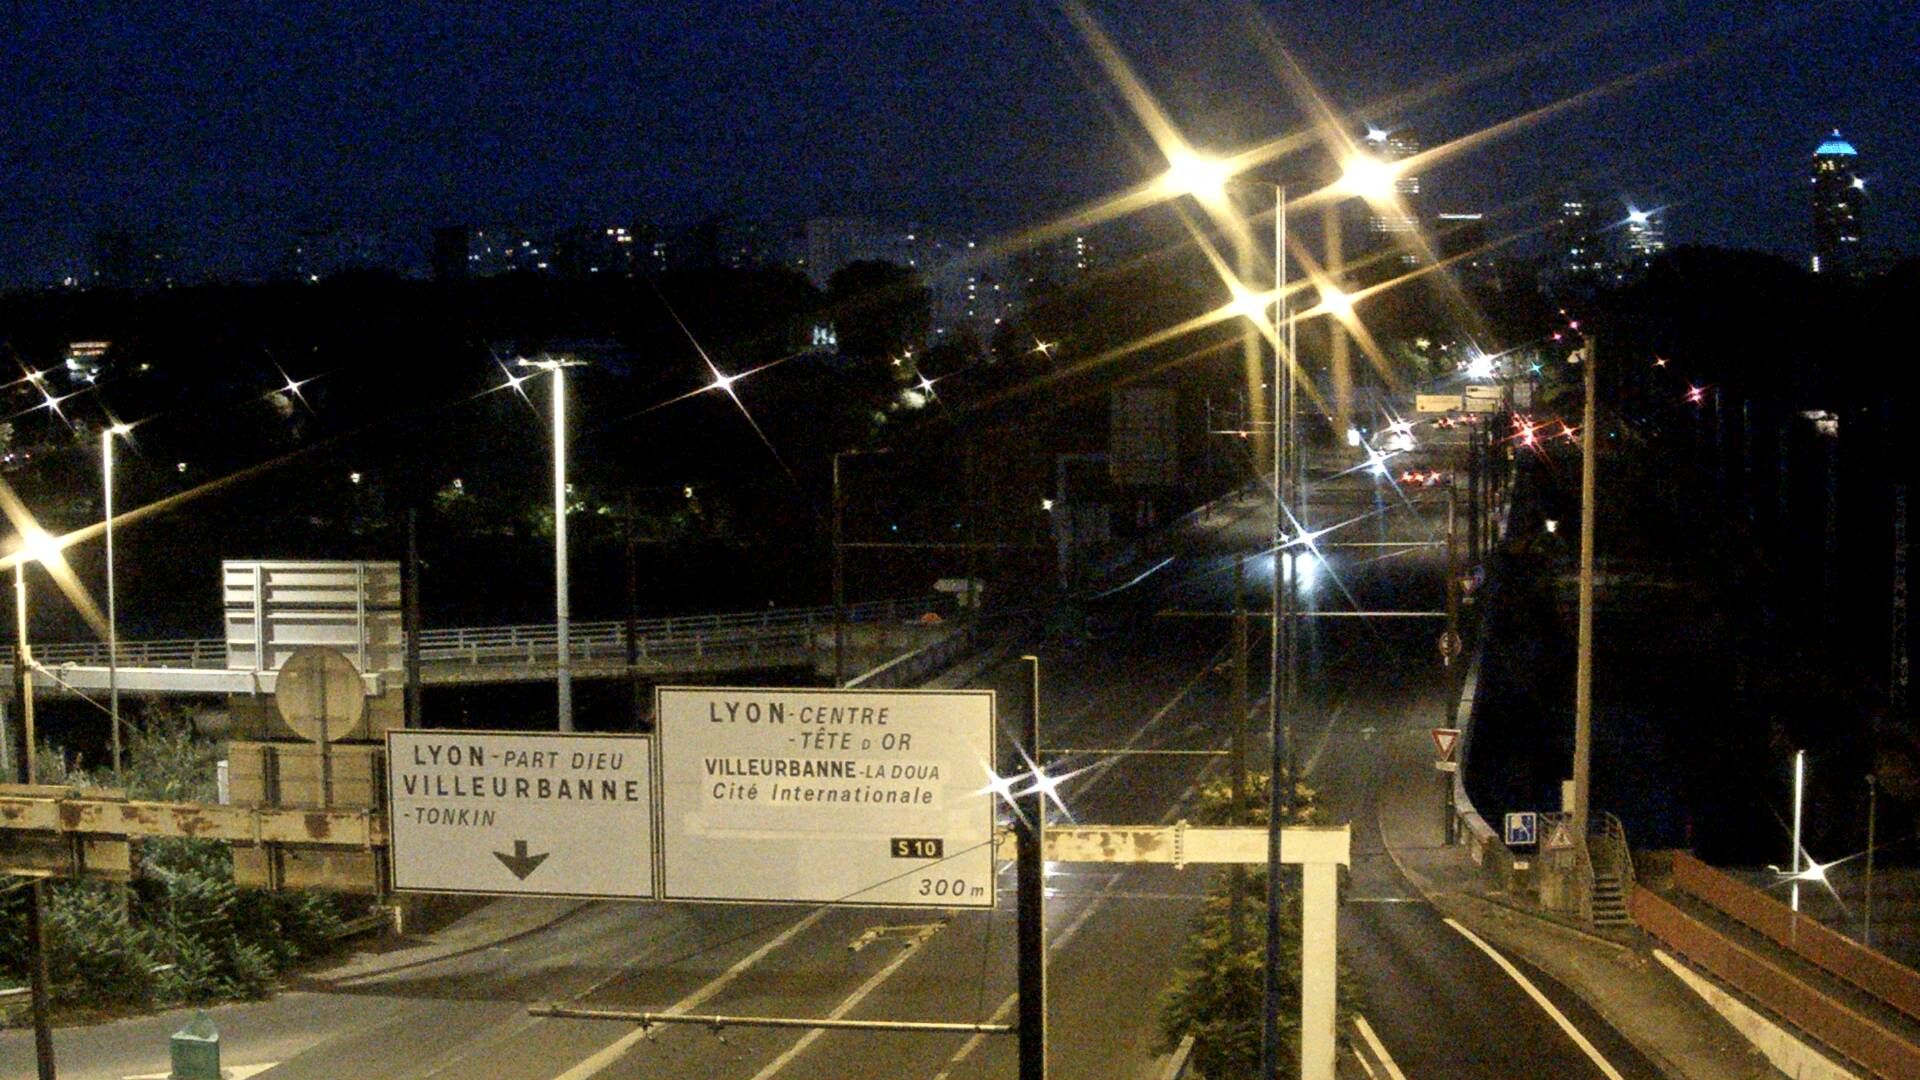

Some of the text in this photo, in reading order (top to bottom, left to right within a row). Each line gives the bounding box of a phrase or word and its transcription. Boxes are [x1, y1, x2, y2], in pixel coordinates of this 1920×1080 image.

[881, 732, 912, 751] OR
[571, 752, 624, 770] DIEU
[891, 764, 940, 780] DOUA
[403, 774, 639, 802] VILLEURBANNE
[712, 781, 933, 804] Cité Internationale
[918, 879, 966, 897] 300
